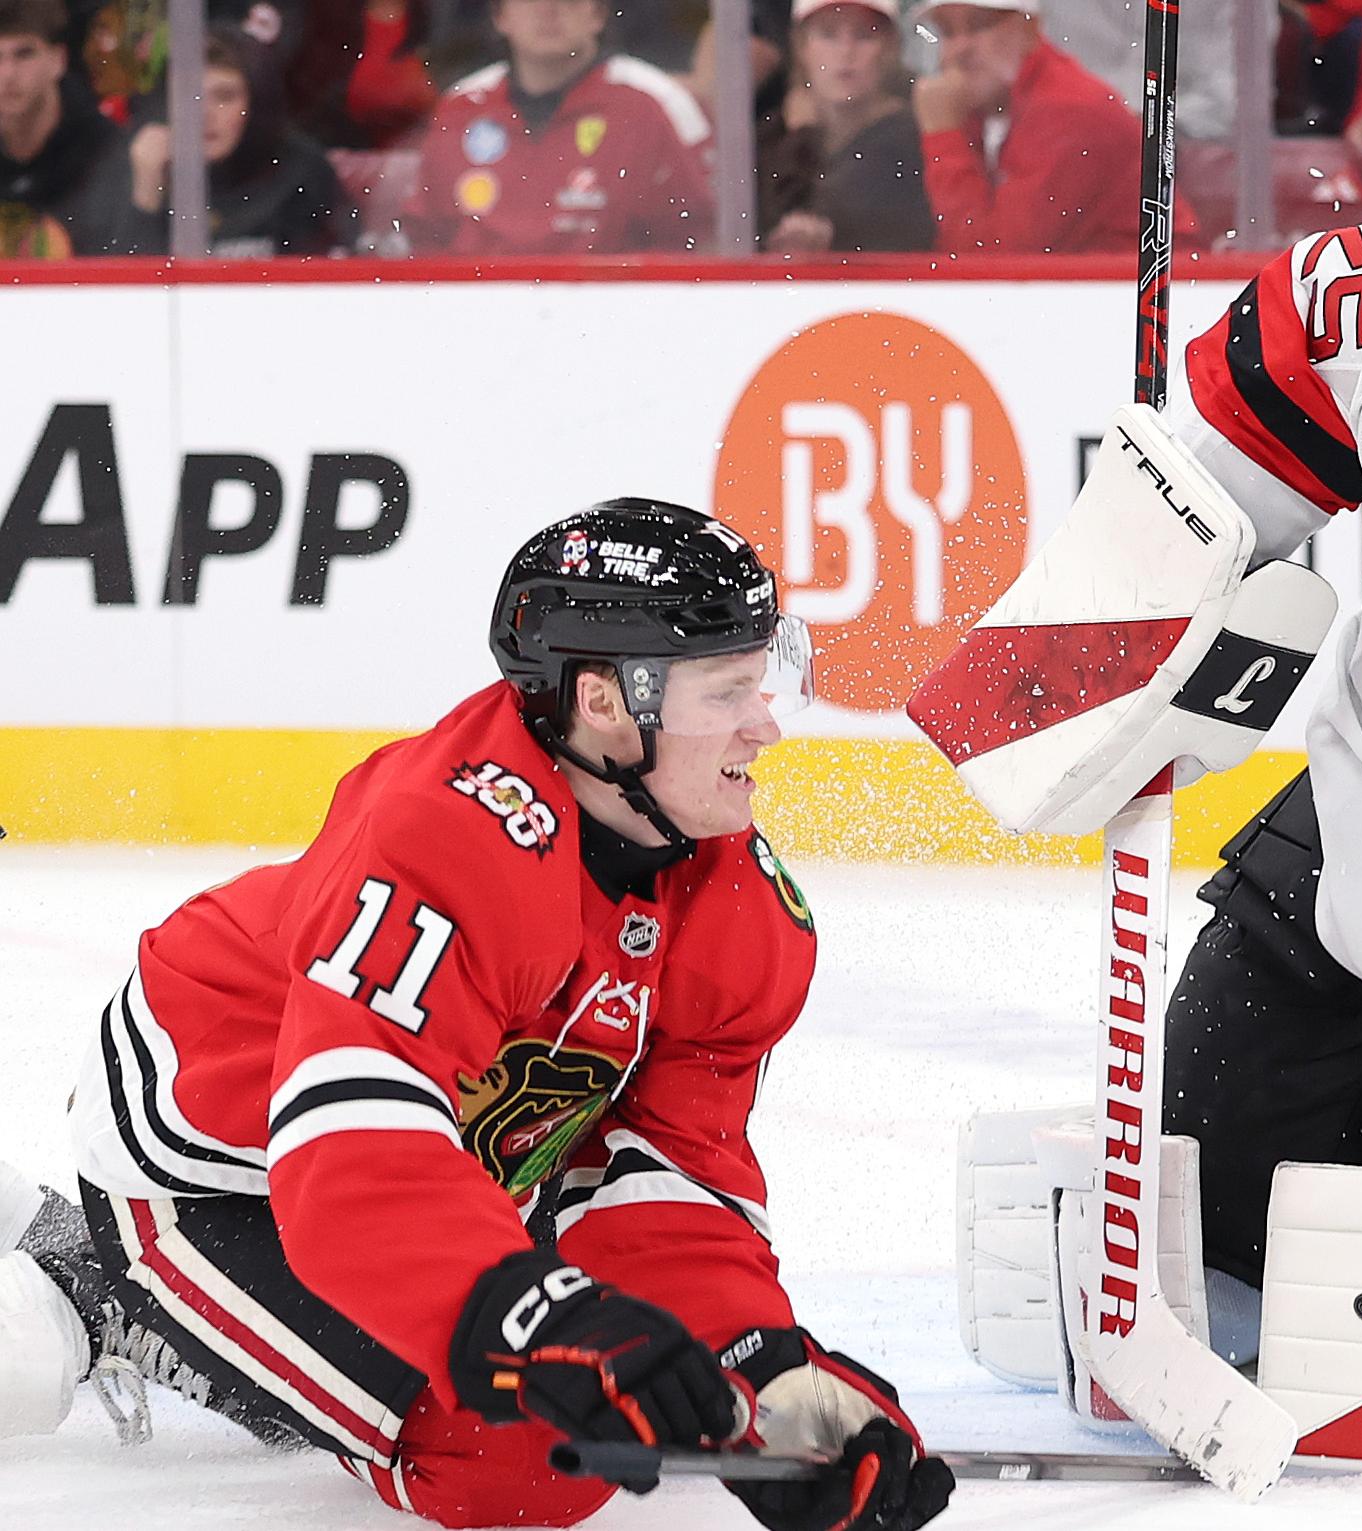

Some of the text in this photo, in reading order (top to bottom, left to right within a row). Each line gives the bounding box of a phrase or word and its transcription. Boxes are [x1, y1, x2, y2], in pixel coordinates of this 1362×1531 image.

[782, 403, 973, 627] BY
[1116, 425, 1217, 546] TRUE
[598, 541, 663, 564] BELLE
[603, 557, 650, 579] TIRE
[452, 761, 558, 849] 100
[306, 878, 455, 1035] 11
[1099, 849, 1150, 1339] WARRIOR
